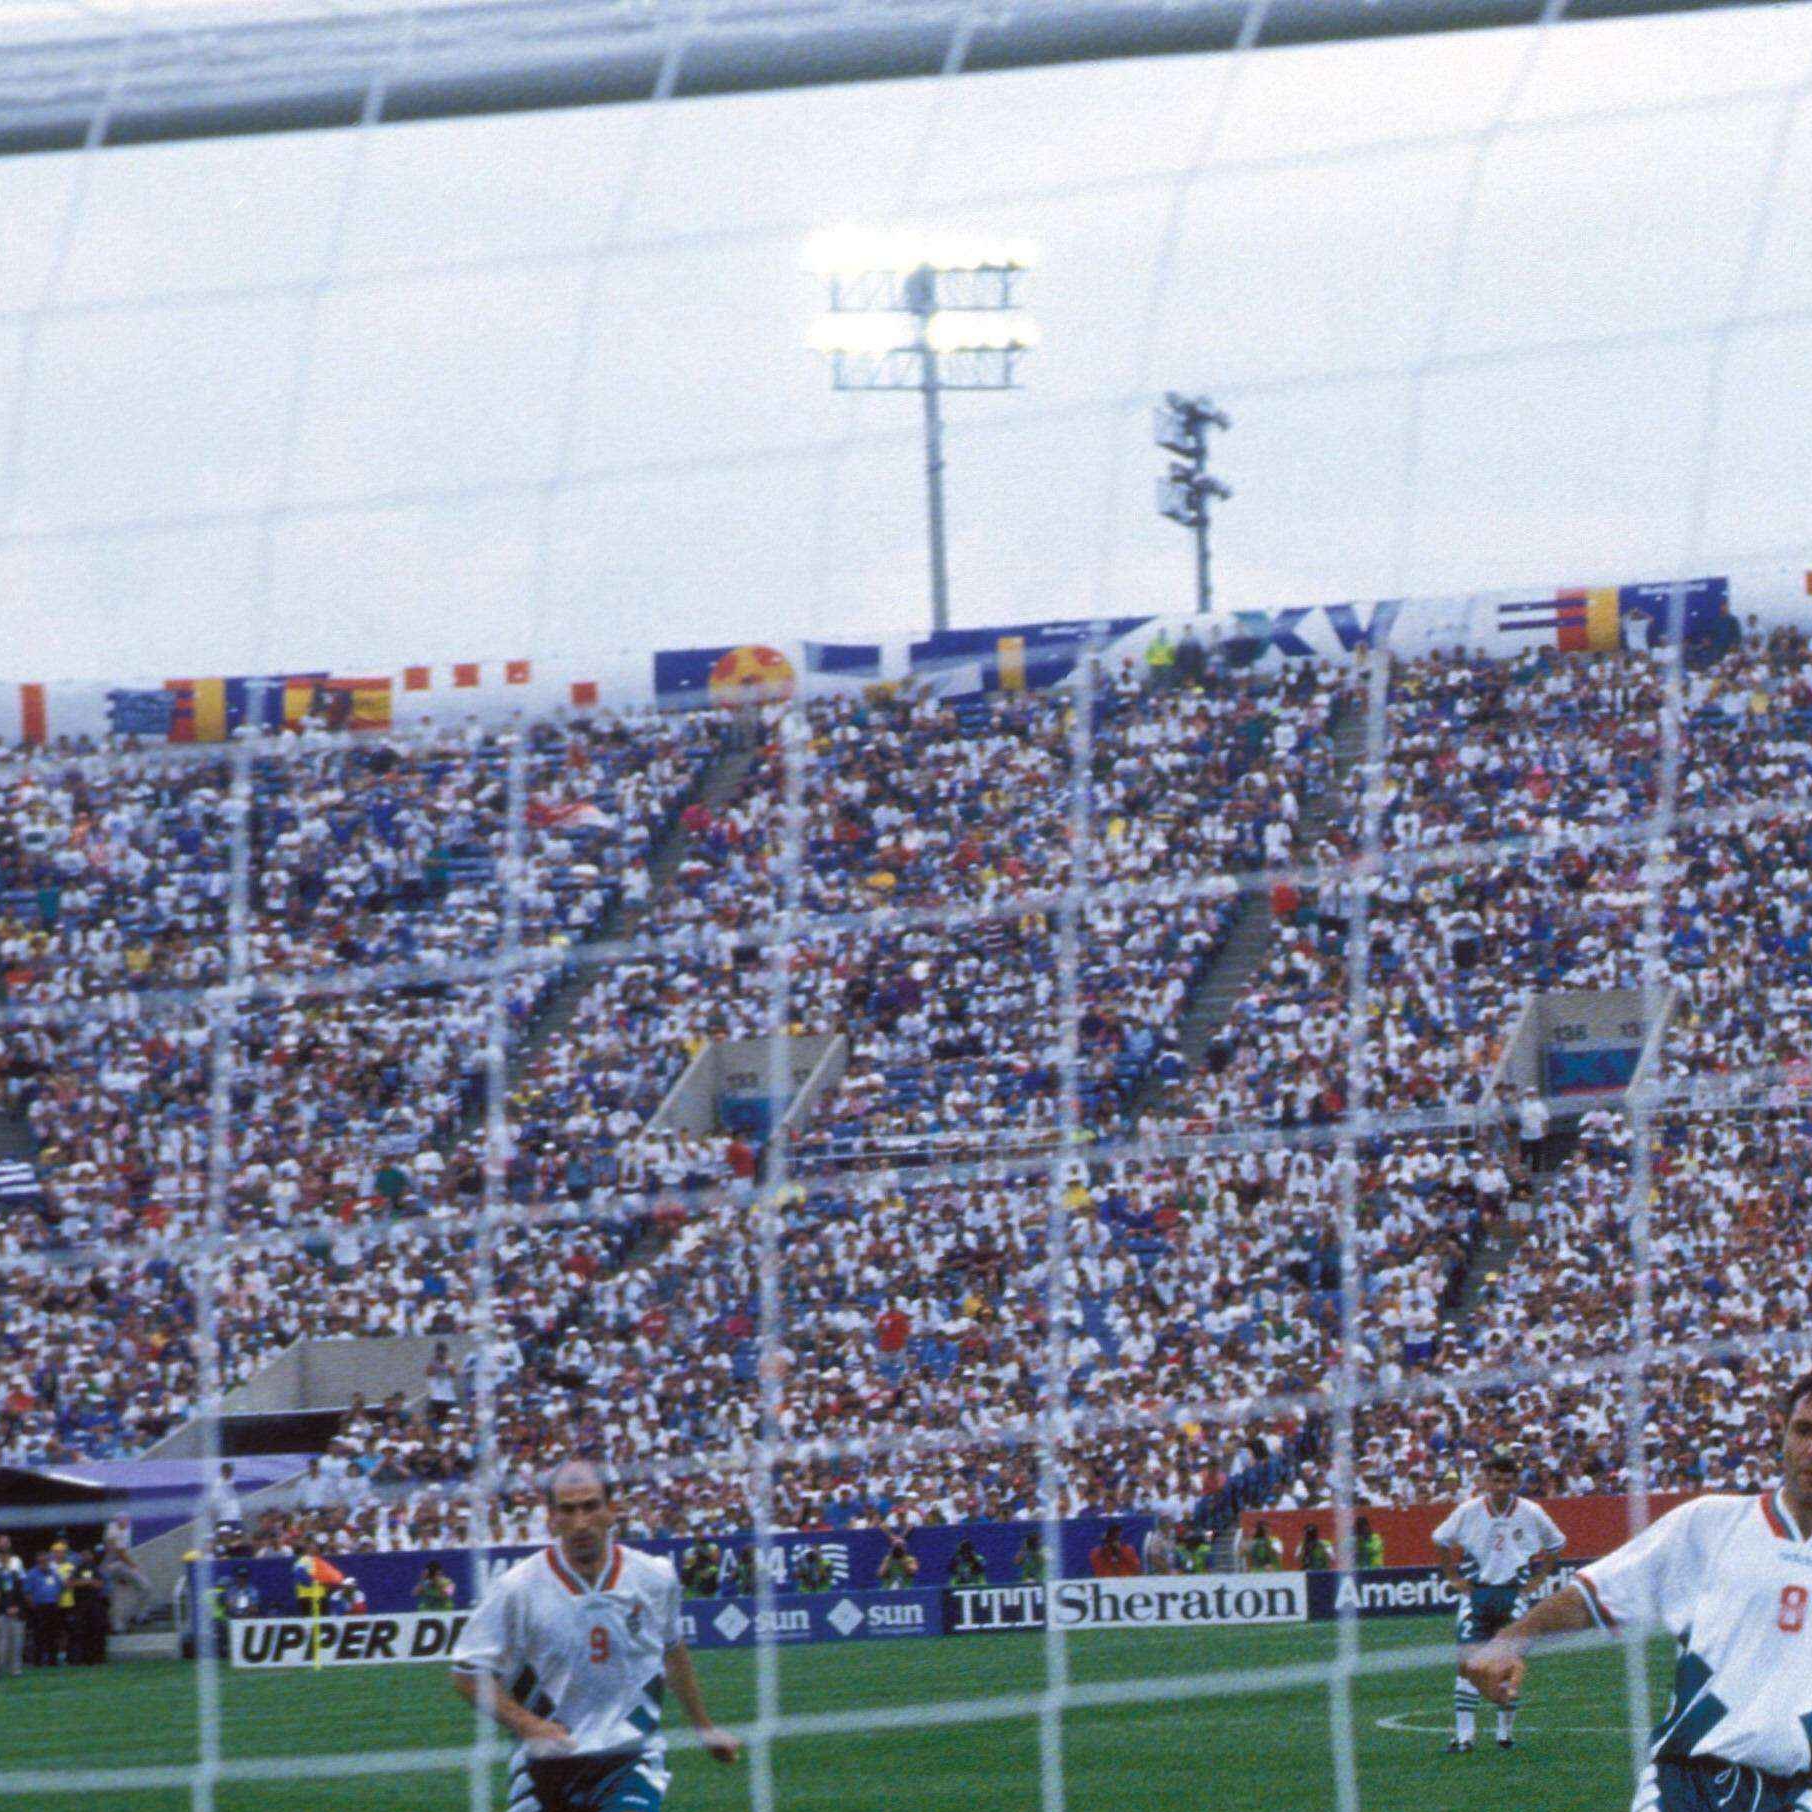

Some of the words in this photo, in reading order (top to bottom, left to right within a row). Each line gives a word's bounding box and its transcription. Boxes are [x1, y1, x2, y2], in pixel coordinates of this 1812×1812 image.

[1054, 1582, 1300, 1624] Sheraton
[1335, 1573, 1459, 1610] Americ
[1778, 1585, 1808, 1633] 8
[867, 1604, 924, 1627] sun
[241, 1619, 400, 1664] UPPER
[590, 1625, 610, 1663] 9
